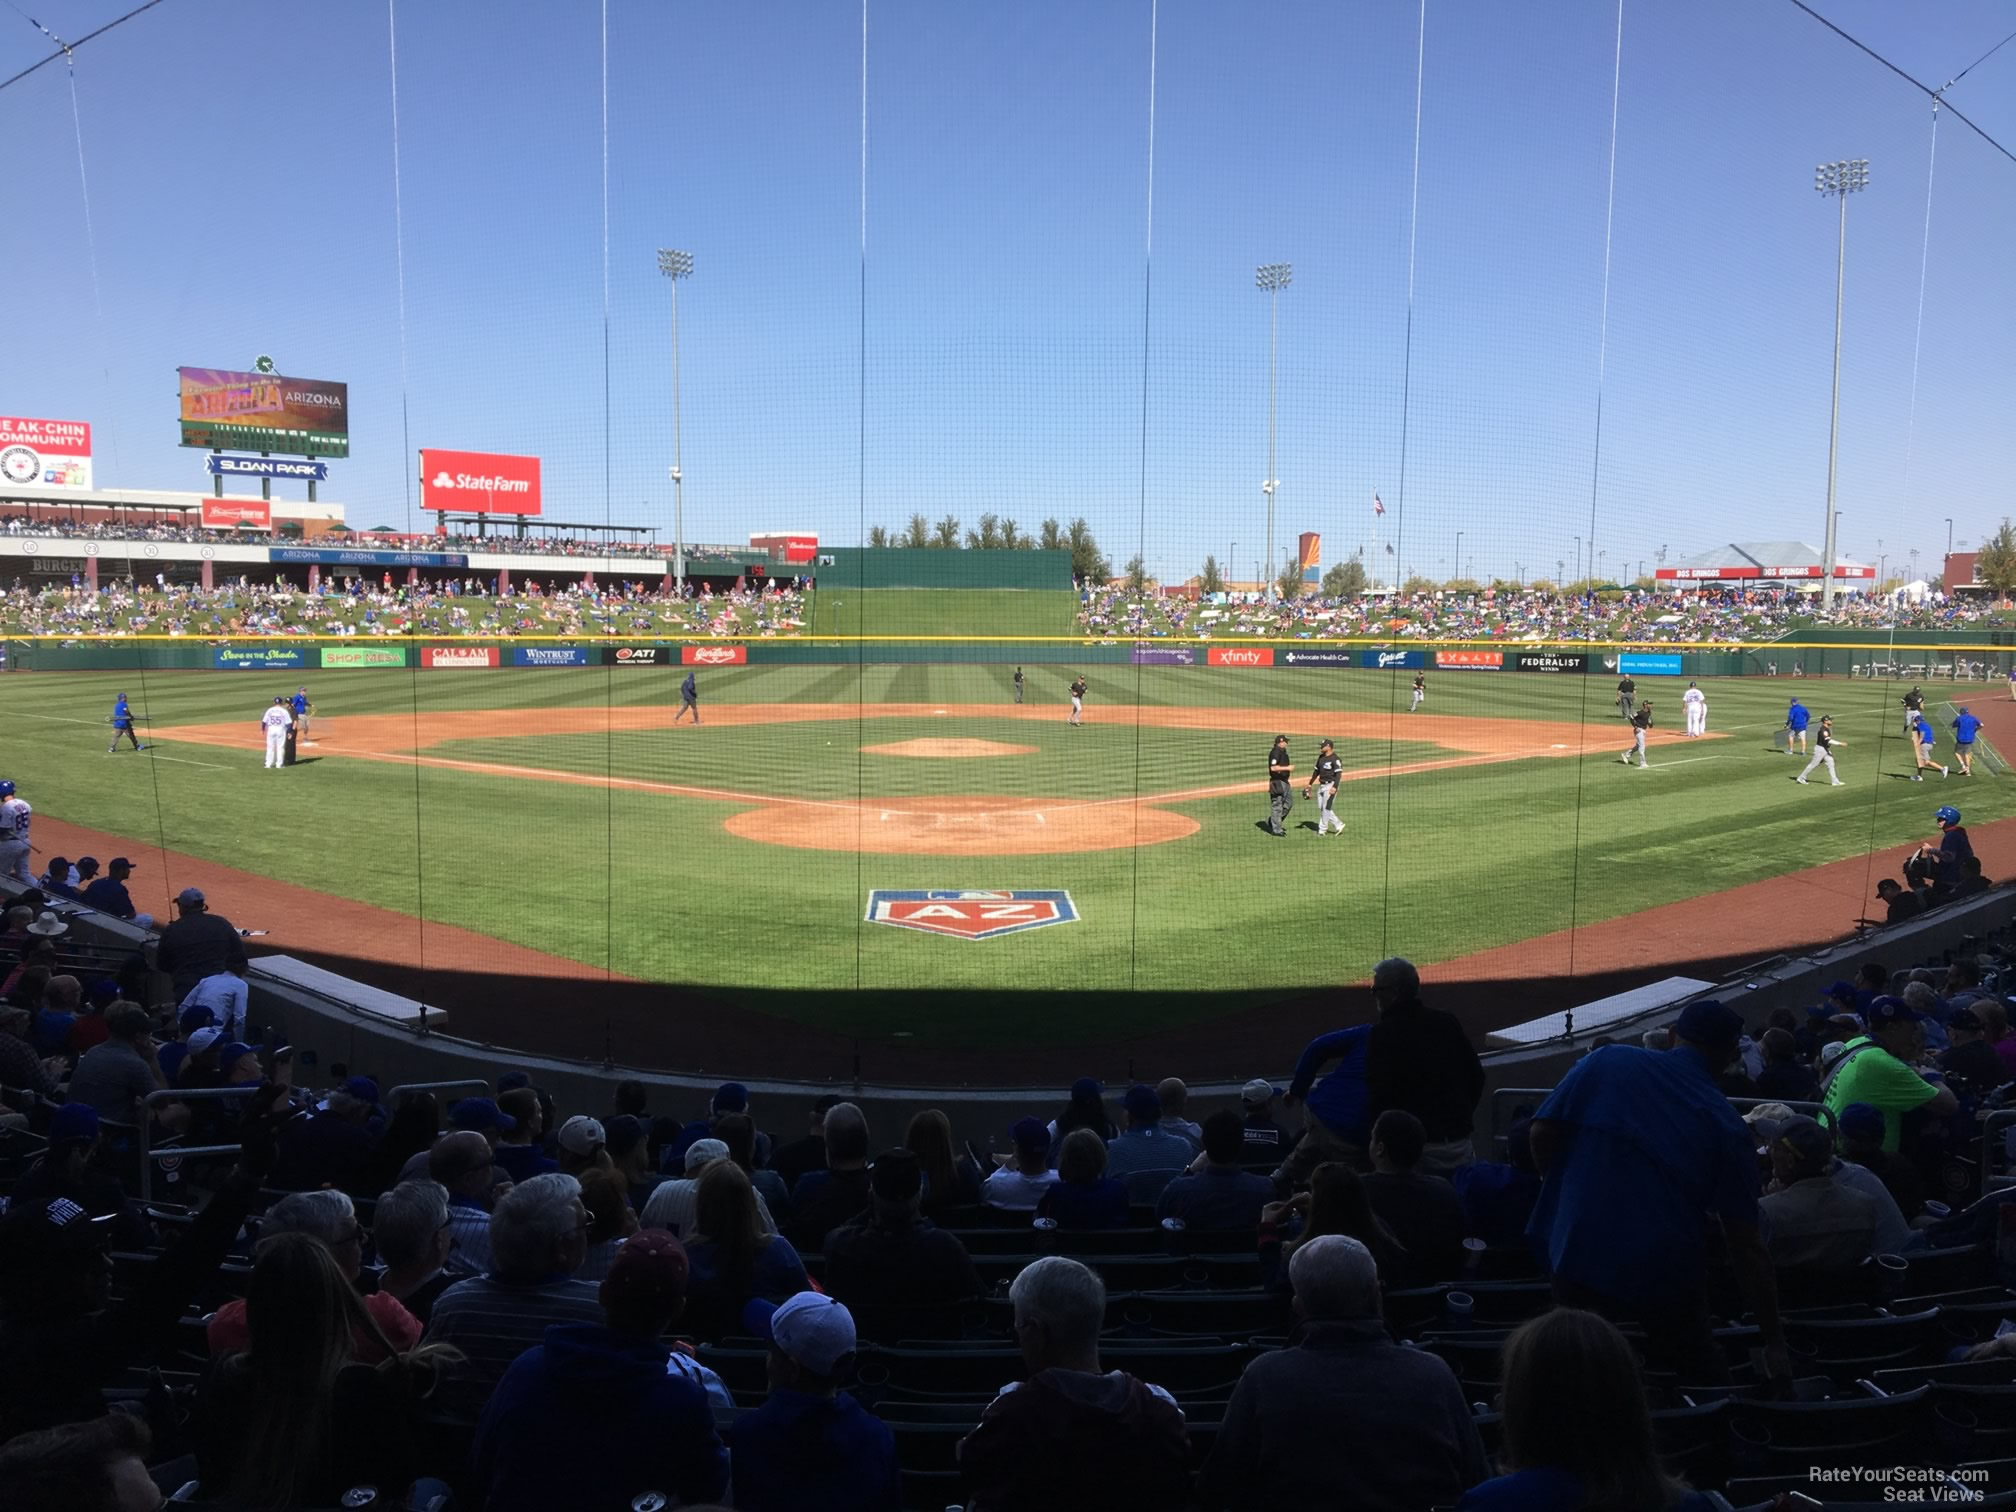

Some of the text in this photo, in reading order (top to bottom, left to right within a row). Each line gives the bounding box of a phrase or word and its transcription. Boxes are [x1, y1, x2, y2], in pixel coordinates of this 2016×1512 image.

[285, 392, 343, 407] ARIZONA
[17, 421, 85, 436] AK-CHIN
[220, 460, 317, 476] SLOAN PARK
[25, 543, 35, 551] 10
[87, 545, 96, 553] 23
[204, 548, 212, 556] 31
[282, 551, 321, 559] ARIZONA
[339, 553, 376, 561] ARIZONA
[1677, 569, 1720, 578] DOS GRINGOS
[1763, 567, 1809, 576] DOS GRINGOS
[220, 650, 245, 661] Save
[432, 648, 489, 657] CAL AM
[526, 648, 576, 658] WINTRUST
[632, 649, 655, 658] ATI
[1220, 650, 1261, 664] xfinity
[327, 653, 401, 663] SHOP MESA
[1521, 658, 1580, 667] FEDERALIST
[270, 715, 282, 725] 55
[903, 904, 1037, 919] AZ
